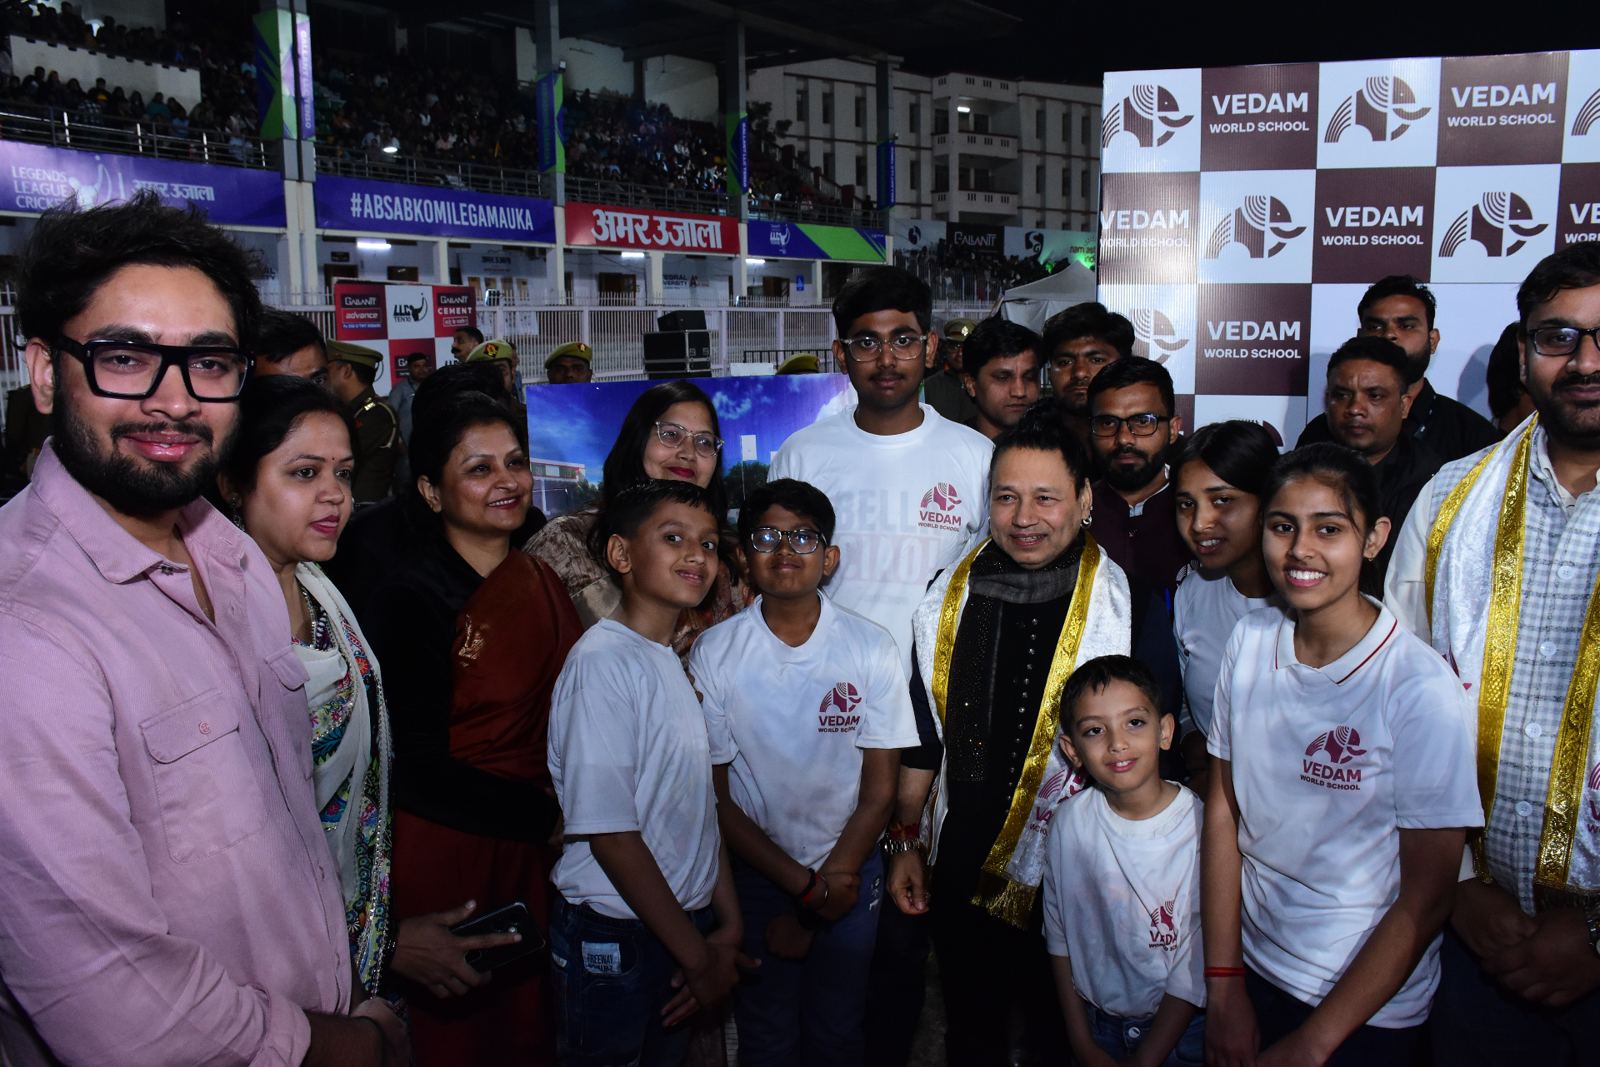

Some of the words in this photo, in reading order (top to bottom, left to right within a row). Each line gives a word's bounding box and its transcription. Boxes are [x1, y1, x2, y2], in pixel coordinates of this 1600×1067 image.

[1212, 92, 1308, 115] VEDAM
[1451, 83, 1556, 108] VEDAM
[1210, 123, 1255, 134] WORLD
[1257, 121, 1309, 132] SCHOOL
[1447, 116, 1496, 127] WORLD
[1499, 113, 1556, 125] SCHOOL
[12, 166, 67, 182] LEGENDS
[14, 180, 69, 197] LEAGUE
[16, 195, 66, 210] CRICKE
[351, 193, 534, 231] #ABSABKOMILEGAMAUKA
[1101, 210, 1189, 229] VEDAM
[1325, 206, 1424, 228] VEDAM
[591, 208, 650, 244] अमर
[652, 214, 722, 249] उजाला
[1321, 236, 1368, 246] WORLD
[1371, 235, 1424, 246] SCHOOL
[1565, 232, 1600, 244] WOR
[437, 306, 472, 315] CEMENT
[1207, 321, 1300, 341] VEDAM
[1204, 349, 1249, 359] WORLD
[1251, 349, 1301, 359] SCHOOL
[919, 510, 962, 526] VEDAM
[818, 715, 861, 726] VEDAM
[1303, 759, 1361, 782] VEDAM
[1300, 774, 1325, 786] WORLD
[1326, 782, 1361, 791] SCHOOL
